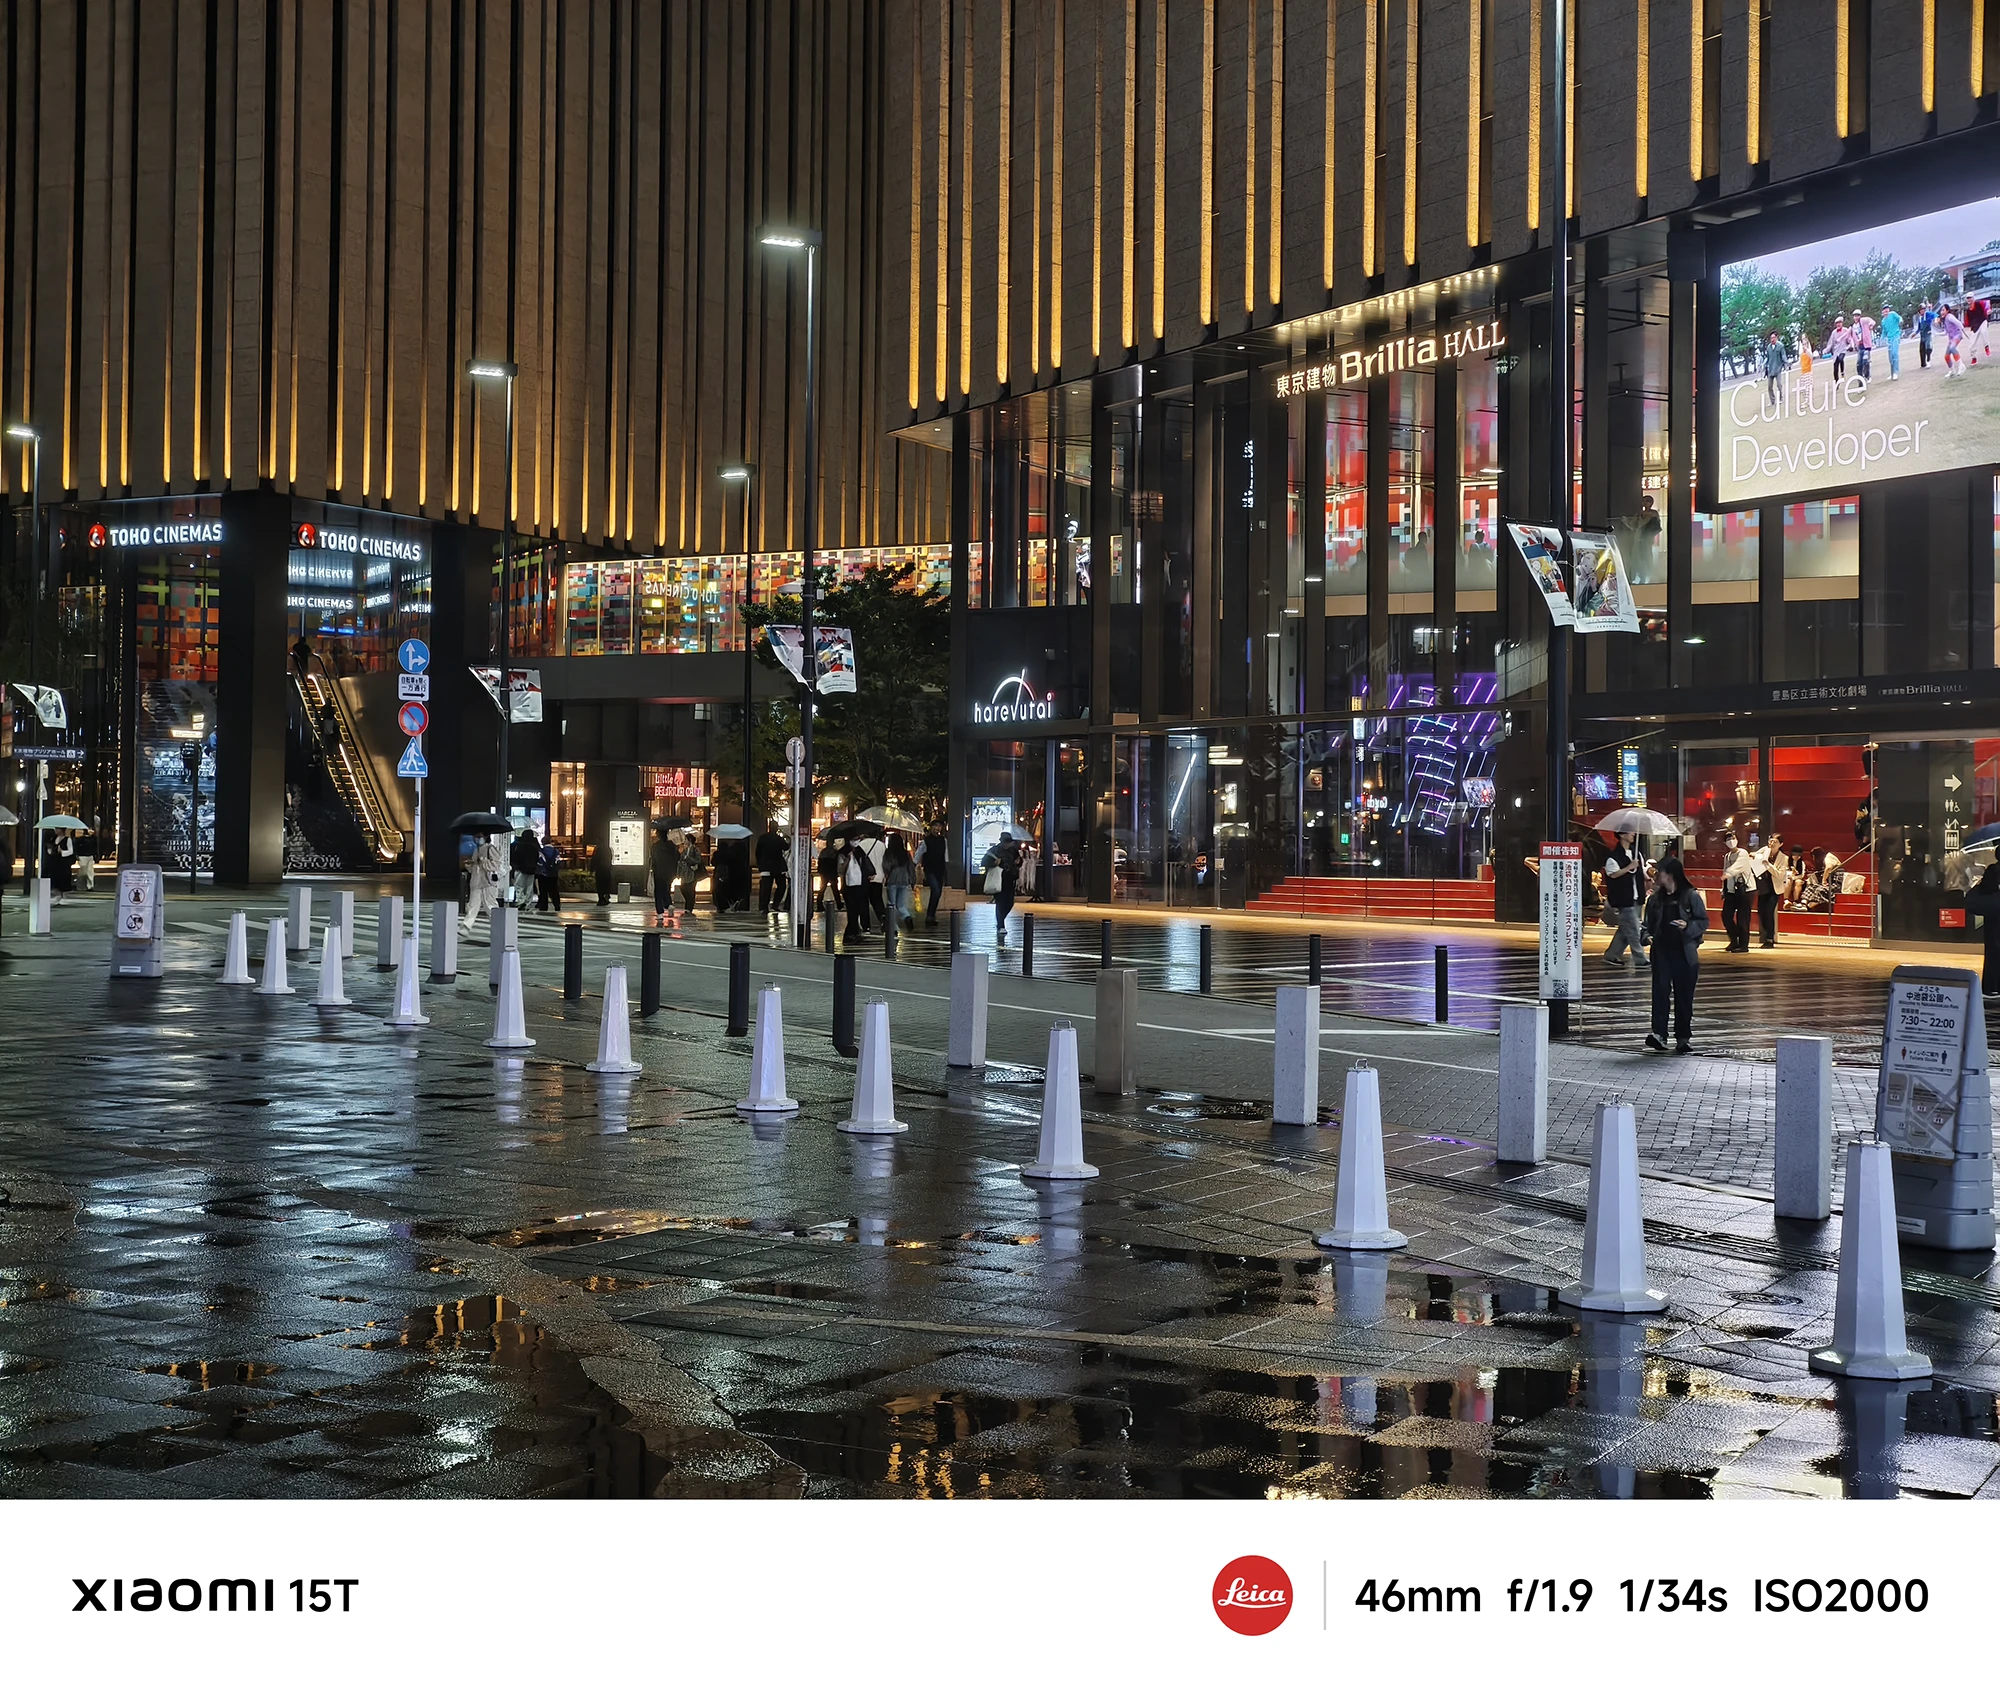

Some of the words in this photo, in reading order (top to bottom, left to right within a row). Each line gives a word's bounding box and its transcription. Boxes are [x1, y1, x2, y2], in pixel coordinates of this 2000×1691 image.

[1276, 363, 1337, 399] 東京建物
[1340, 337, 1438, 384] Brillia
[1443, 321, 1506, 358] HALL
[1730, 371, 1867, 427] Culture
[1732, 417, 1929, 482] Developer
[109, 527, 150, 546] TOHO
[153, 523, 222, 544] CINEMAS
[319, 531, 358, 552] TOHO
[360, 538, 421, 561] CINEMAS
[307, 597, 354, 610] CINEMAS
[974, 676, 1053, 723] harevutai
[1906, 684, 1941, 695] Brillia
[1543, 846, 1579, 856] 開催告知
[1906, 992, 1952, 1003] 中池袋公園へ
